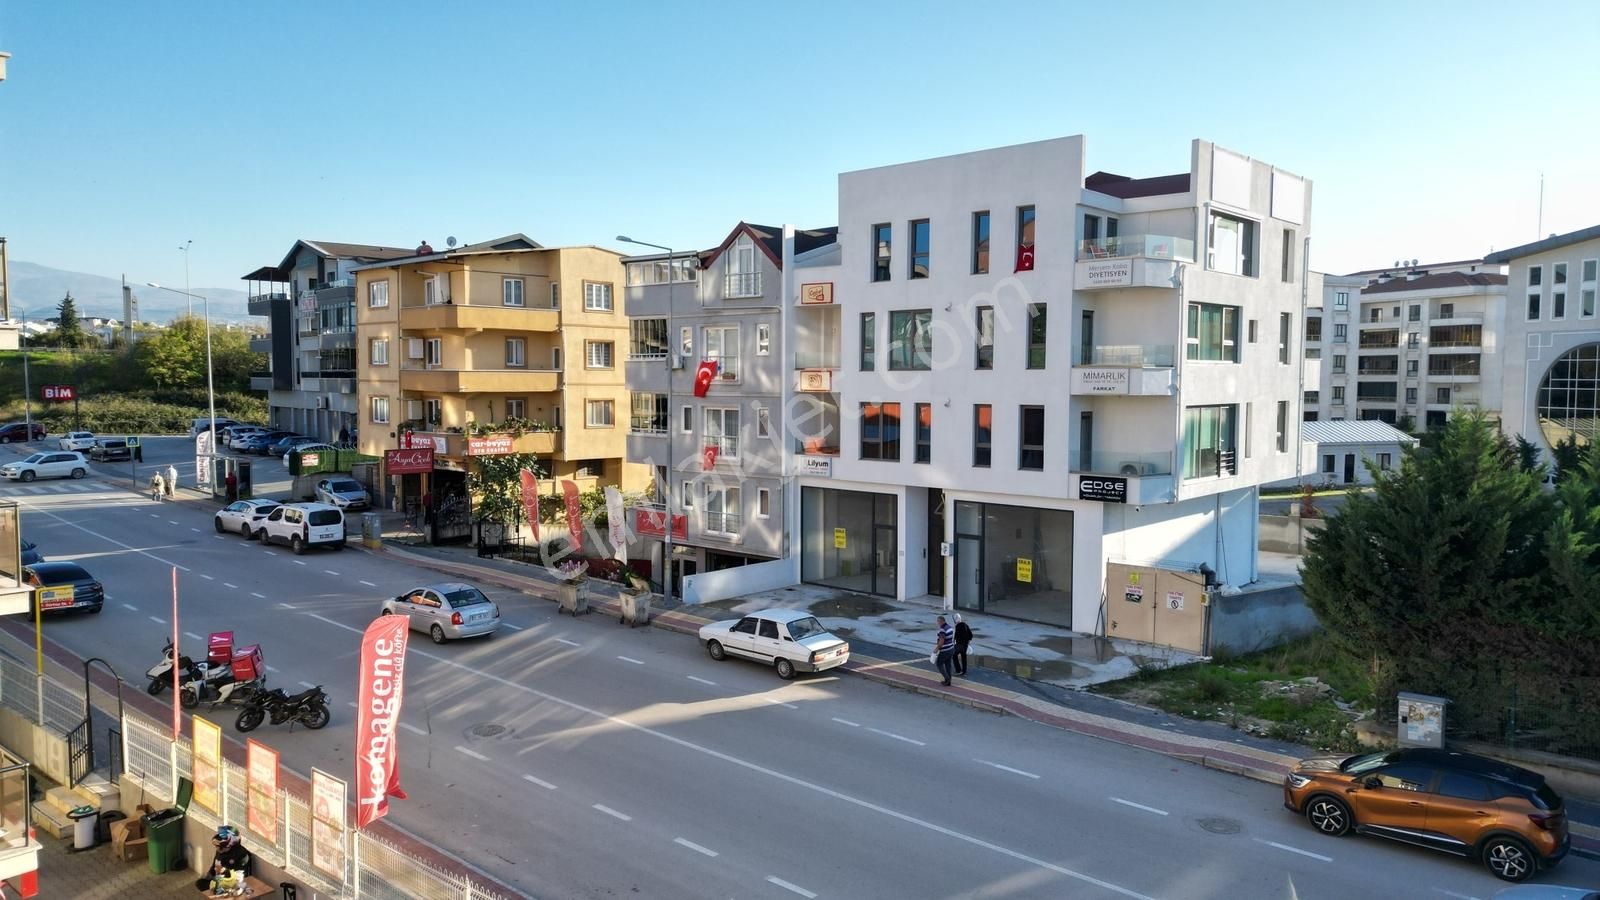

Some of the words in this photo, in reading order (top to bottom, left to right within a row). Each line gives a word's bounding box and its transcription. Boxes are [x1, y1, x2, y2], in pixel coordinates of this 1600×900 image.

[45, 386, 72, 399] BİM
[807, 459, 829, 468] Lilyum
[1080, 480, 1124, 493] EDGE
[360, 637, 395, 808] komagene
